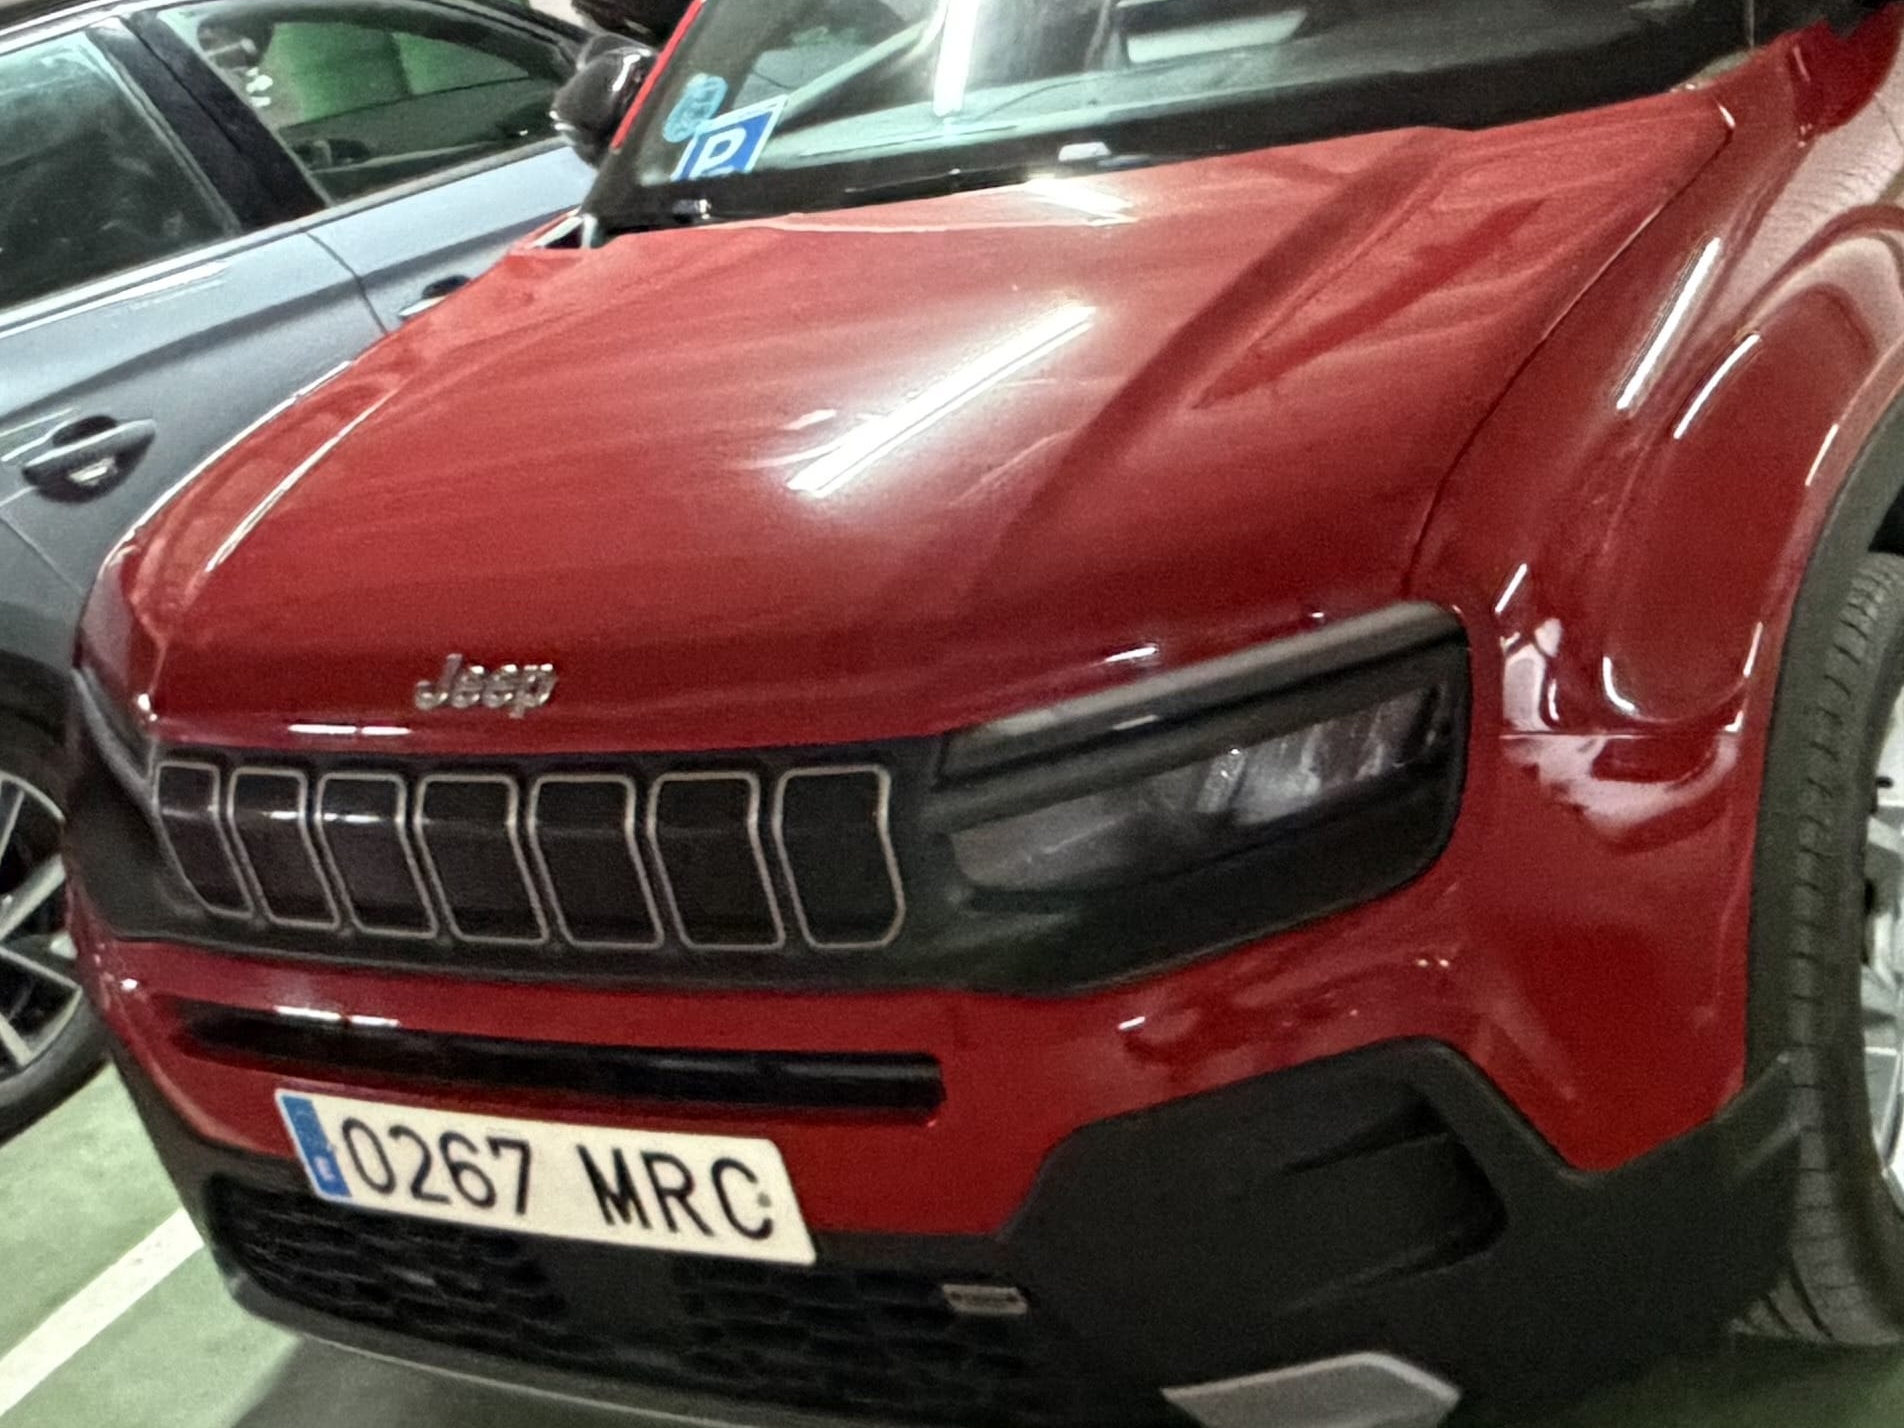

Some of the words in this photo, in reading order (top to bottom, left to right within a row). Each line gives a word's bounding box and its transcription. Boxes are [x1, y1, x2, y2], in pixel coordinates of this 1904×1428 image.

[415, 653, 558, 719] Jeep
[341, 1117, 532, 1216] 0267
[575, 1143, 774, 1241] MRC
